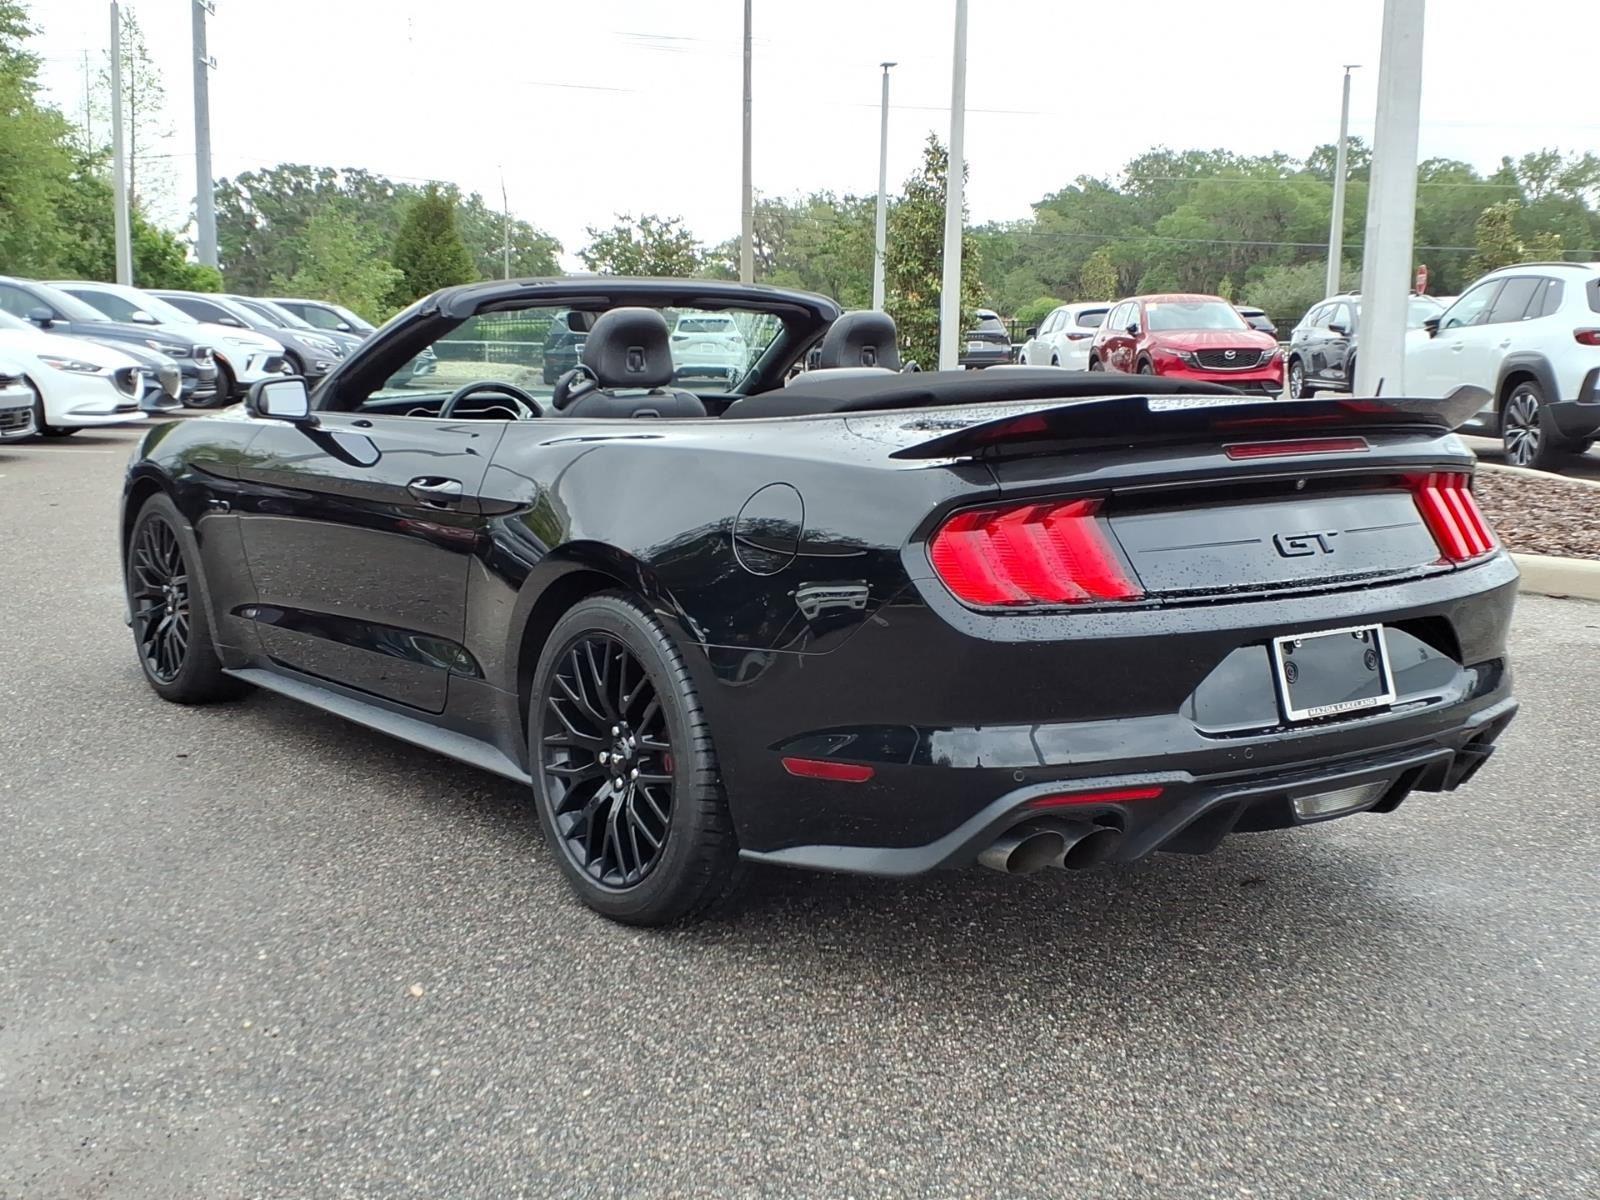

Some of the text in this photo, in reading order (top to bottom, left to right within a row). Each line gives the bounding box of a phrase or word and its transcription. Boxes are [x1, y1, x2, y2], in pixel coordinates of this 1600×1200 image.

[1272, 531, 1338, 558] GT
[1309, 698, 1377, 716] MAZDA LAKELAND
